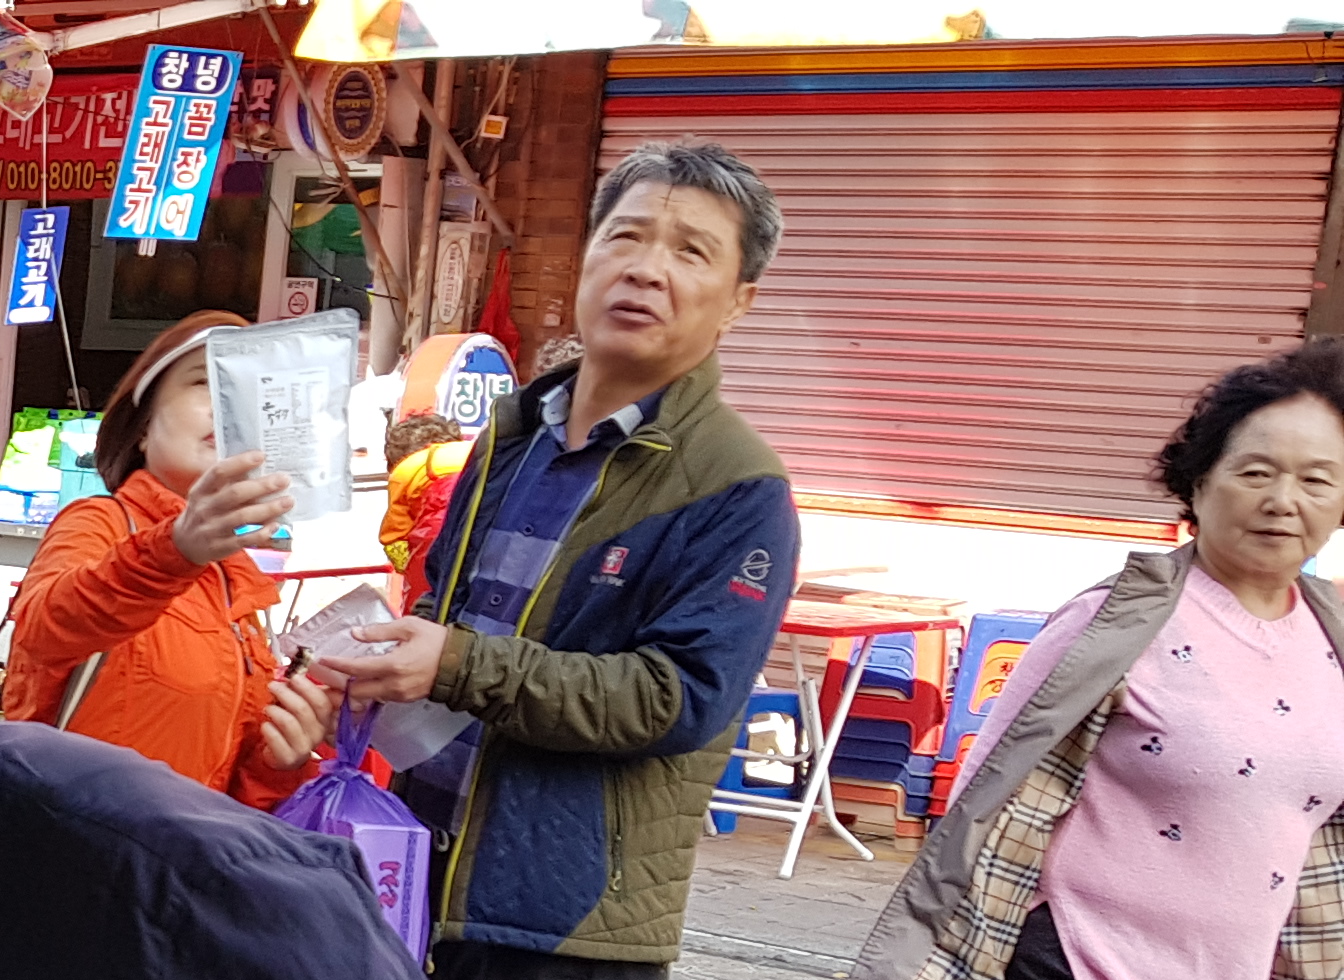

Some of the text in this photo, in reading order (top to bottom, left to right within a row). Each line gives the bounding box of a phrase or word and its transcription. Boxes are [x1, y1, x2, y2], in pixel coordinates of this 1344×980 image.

[161, 52, 223, 92] 창녕
[6, 160, 119, 190] 010-8010-3
[119, 97, 176, 234] 고래고기
[161, 99, 217, 236] 꼼장어
[15, 213, 56, 307] 고래고기
